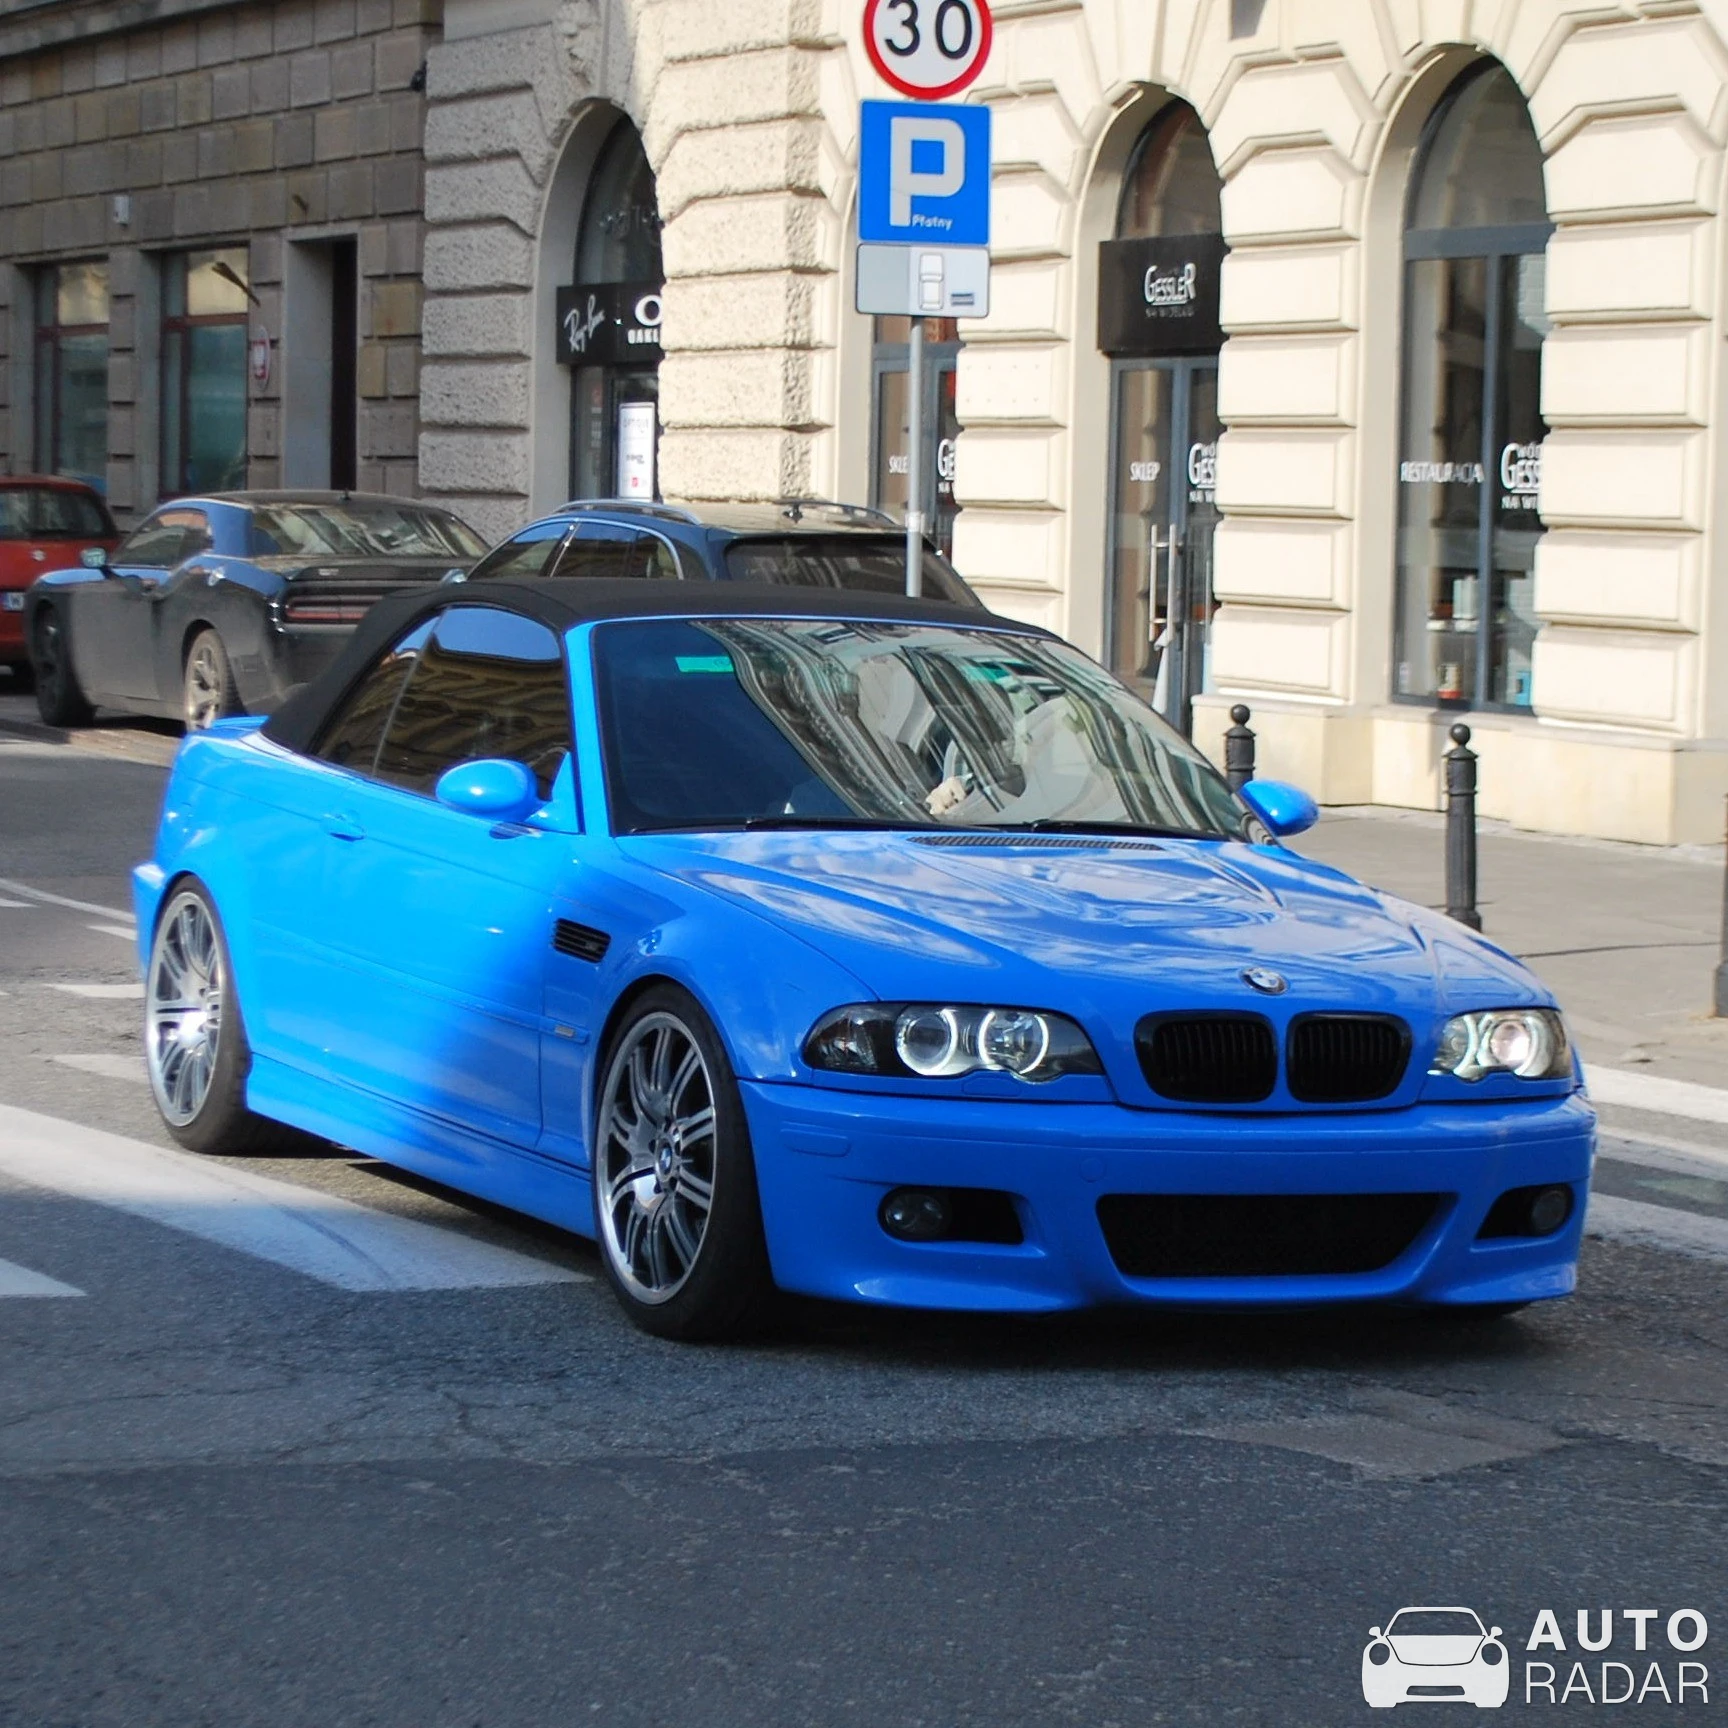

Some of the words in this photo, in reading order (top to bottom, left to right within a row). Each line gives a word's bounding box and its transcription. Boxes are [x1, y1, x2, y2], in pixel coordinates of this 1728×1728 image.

[884, 0, 973, 60] 30
[889, 116, 966, 228] P
[627, 328, 660, 344] OAKL
[888, 454, 909, 474] SKLE
[1129, 461, 1161, 481] SKLEP
